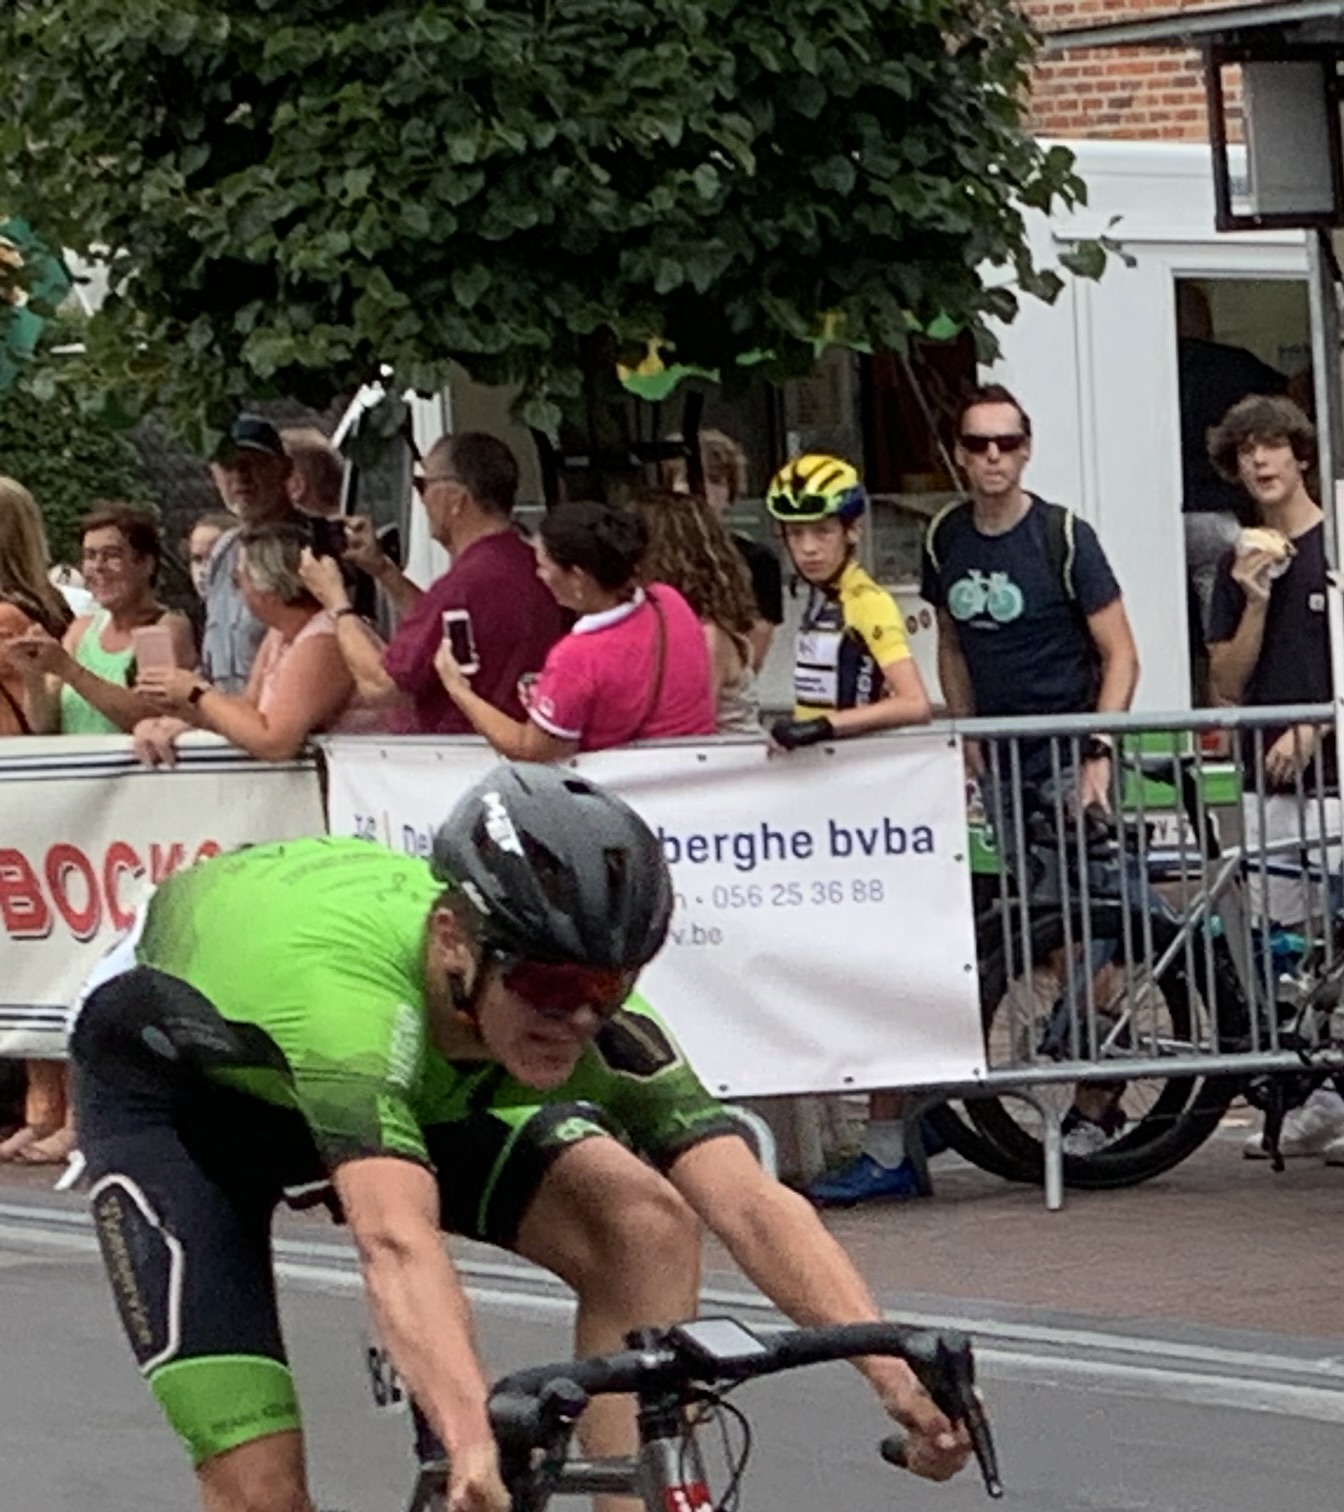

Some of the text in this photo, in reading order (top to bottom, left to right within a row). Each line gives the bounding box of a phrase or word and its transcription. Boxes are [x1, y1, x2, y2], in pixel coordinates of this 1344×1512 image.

[828, 816, 935, 858] bvba
[711, 884, 764, 910] 056
[770, 882, 804, 907] 25
[810, 880, 844, 905] 36
[851, 878, 885, 903] 88
